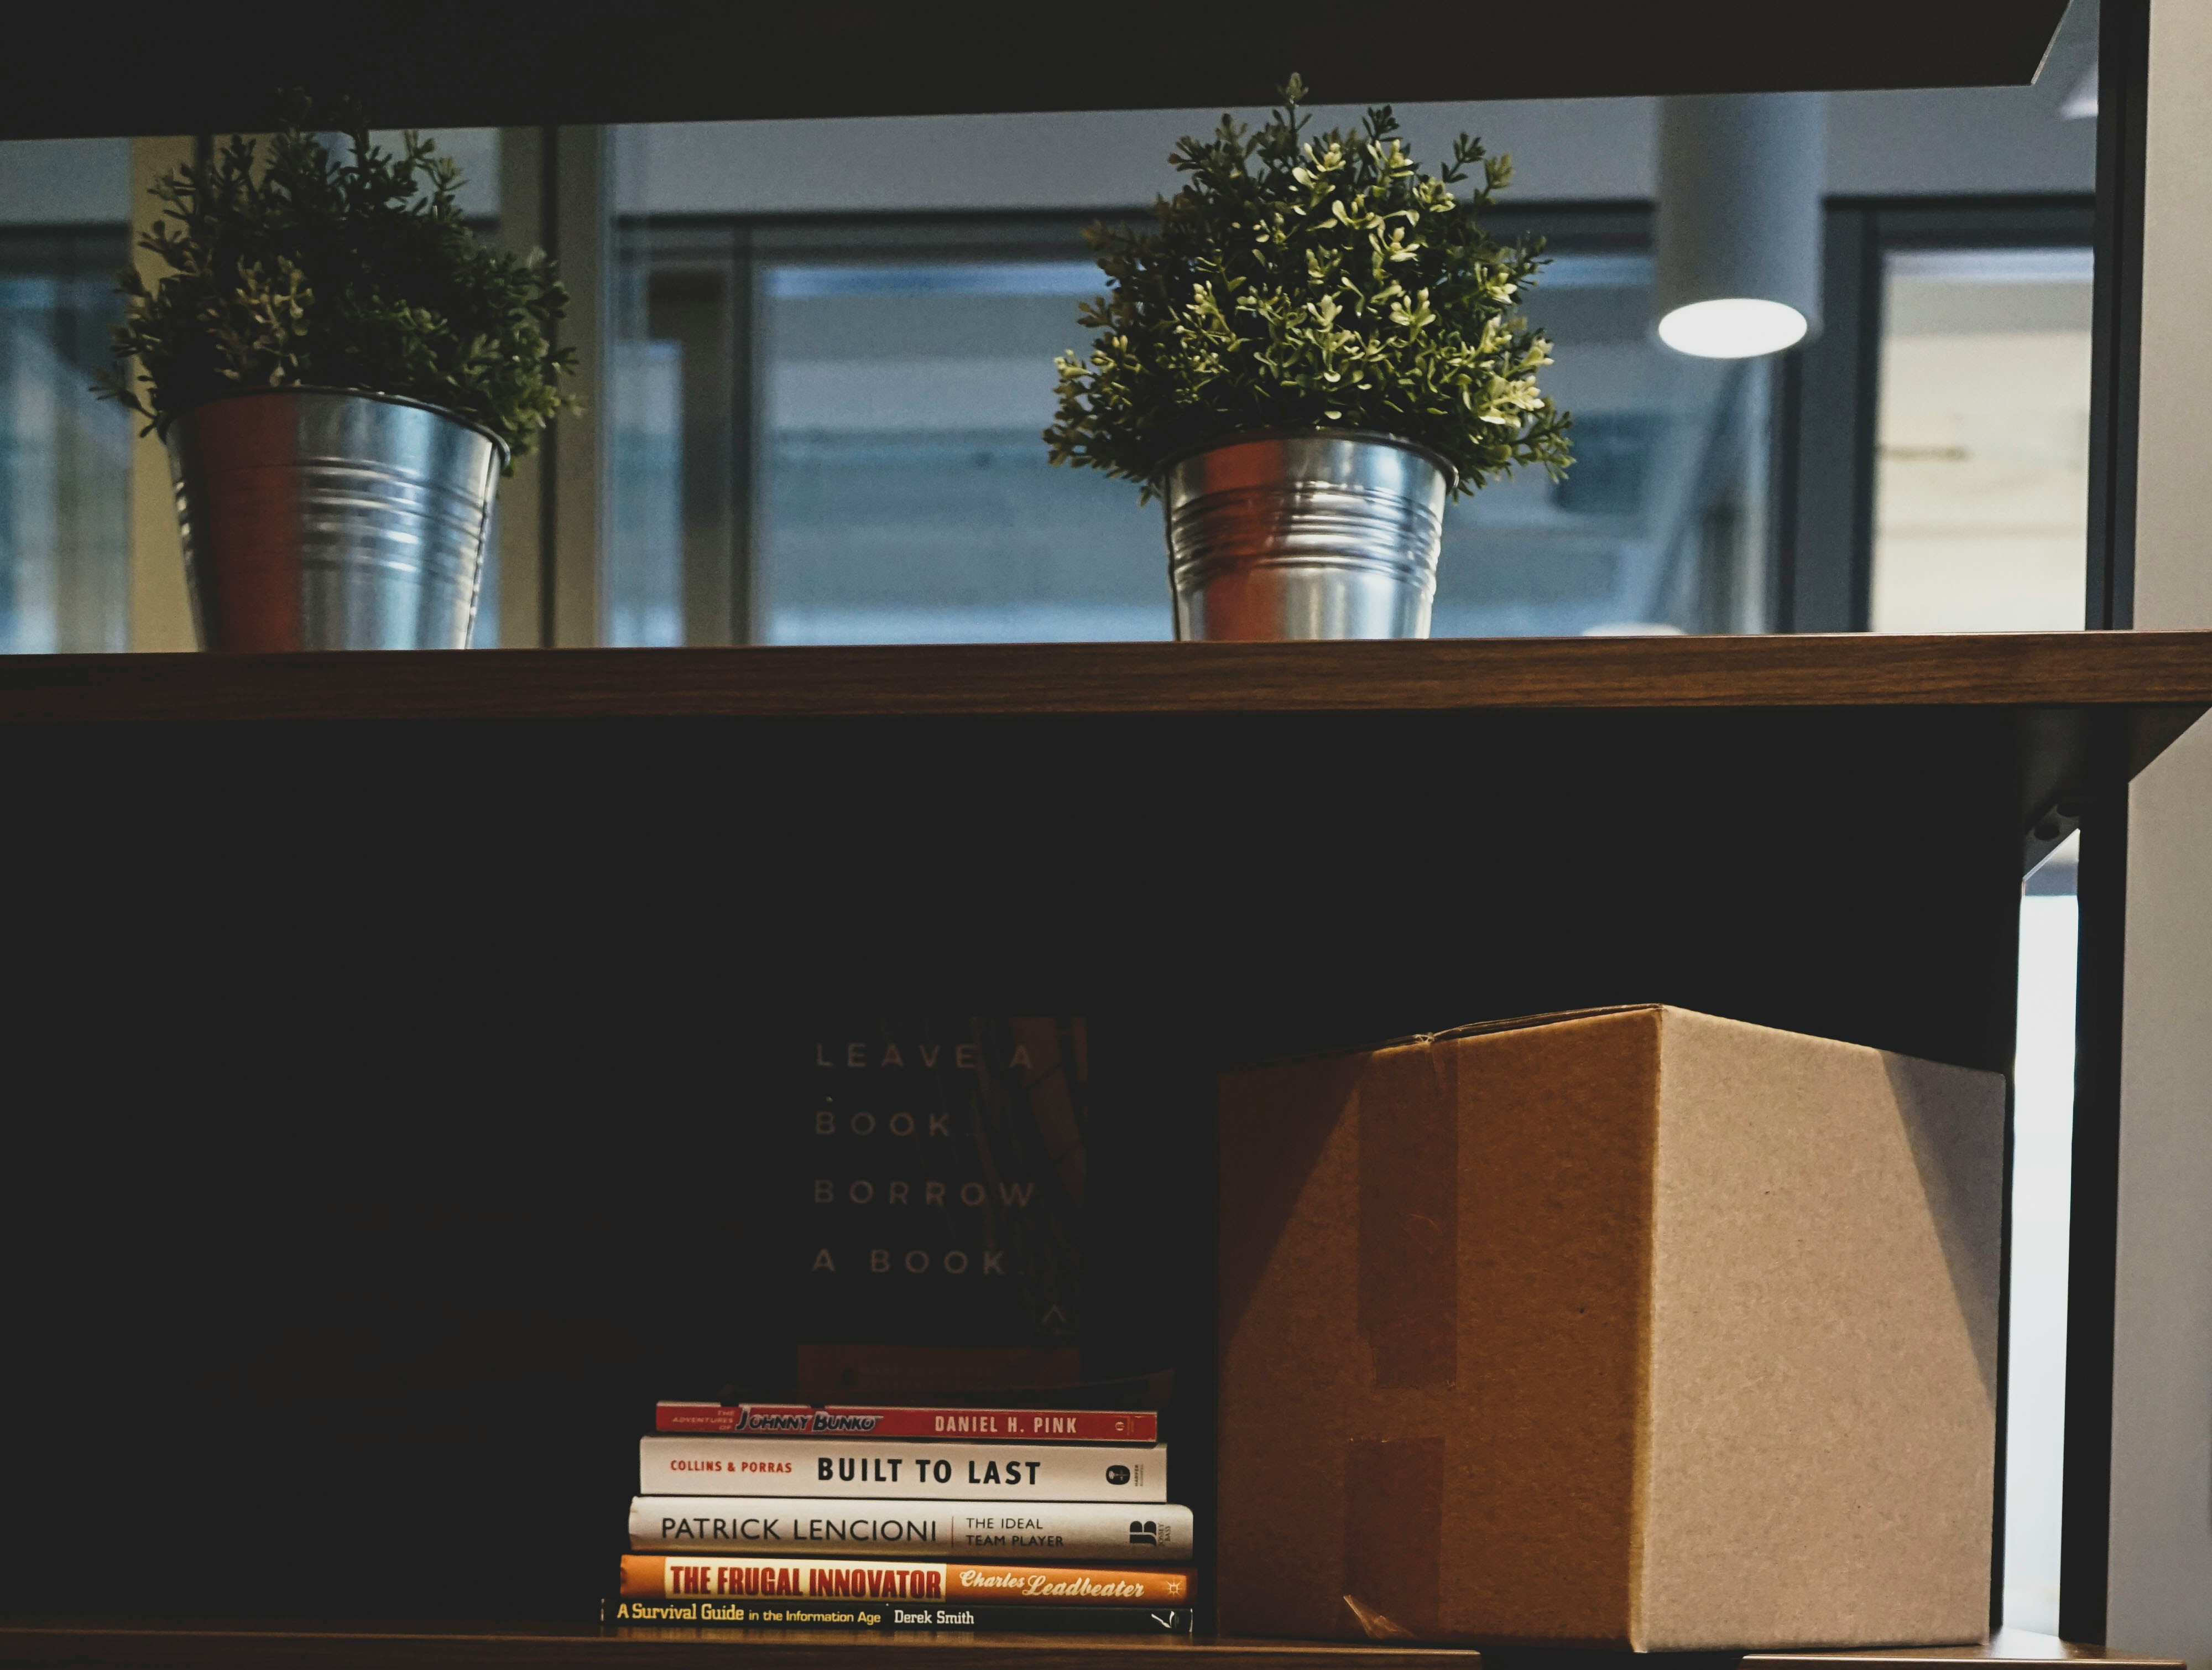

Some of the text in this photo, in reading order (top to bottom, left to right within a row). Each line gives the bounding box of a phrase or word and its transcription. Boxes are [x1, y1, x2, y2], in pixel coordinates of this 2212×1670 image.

[816, 1043, 1034, 1070] LEAVE A
[813, 1179, 1035, 1208] BORROW
[811, 1248, 836, 1273] A
[812, 1411, 884, 1432] BUNKO
[935, 1416, 1077, 1434] DANIEL H. PINK
[671, 1460, 792, 1473] COLLINS & PORRAS
[818, 1458, 1041, 1485] BUILT TO LAST
[662, 1518, 936, 1542] PATRICK LENCIONI
[966, 1518, 1043, 1529] THE IDEAL
[966, 1534, 1063, 1547] TEAM PLAYER
[670, 1567, 942, 1598] THE FRUGAL INNOVATOR
[959, 1569, 1144, 1598] Charles Leadbeater
[617, 1603, 881, 1625] A Survival Guide in the Information Age
[895, 1610, 974, 1624] Derek Smith
